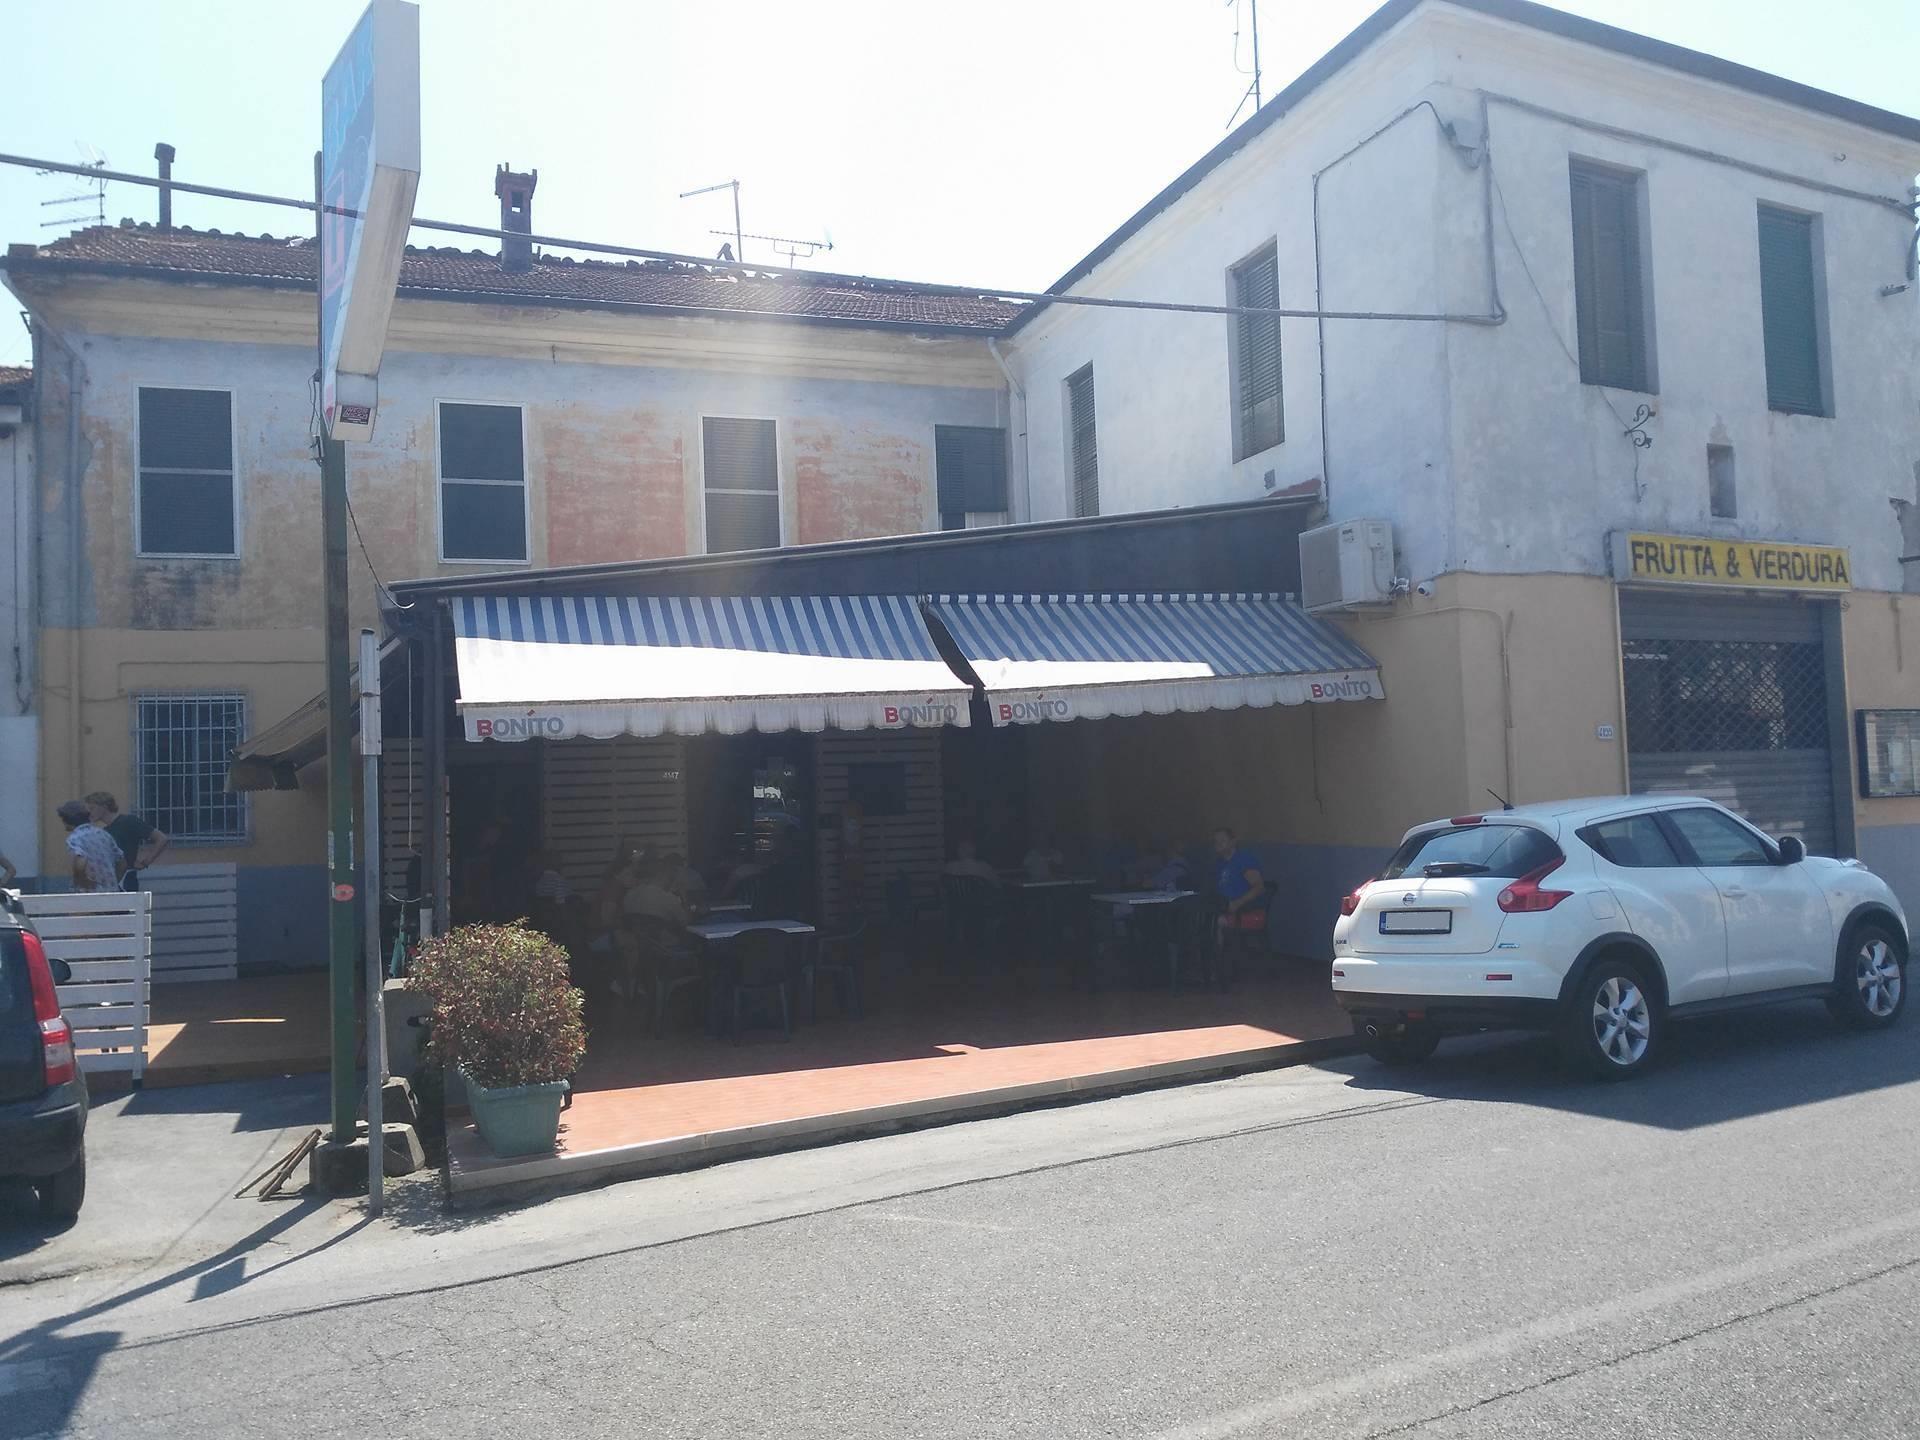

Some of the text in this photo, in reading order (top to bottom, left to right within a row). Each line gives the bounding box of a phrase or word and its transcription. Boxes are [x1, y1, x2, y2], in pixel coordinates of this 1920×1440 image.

[1631, 541, 1849, 583] FRUTTA & VERDURA
[1311, 681, 1371, 698] BONITO
[884, 704, 957, 723] BONITO
[998, 700, 1068, 720] BONITO
[476, 717, 564, 736] BONITO
